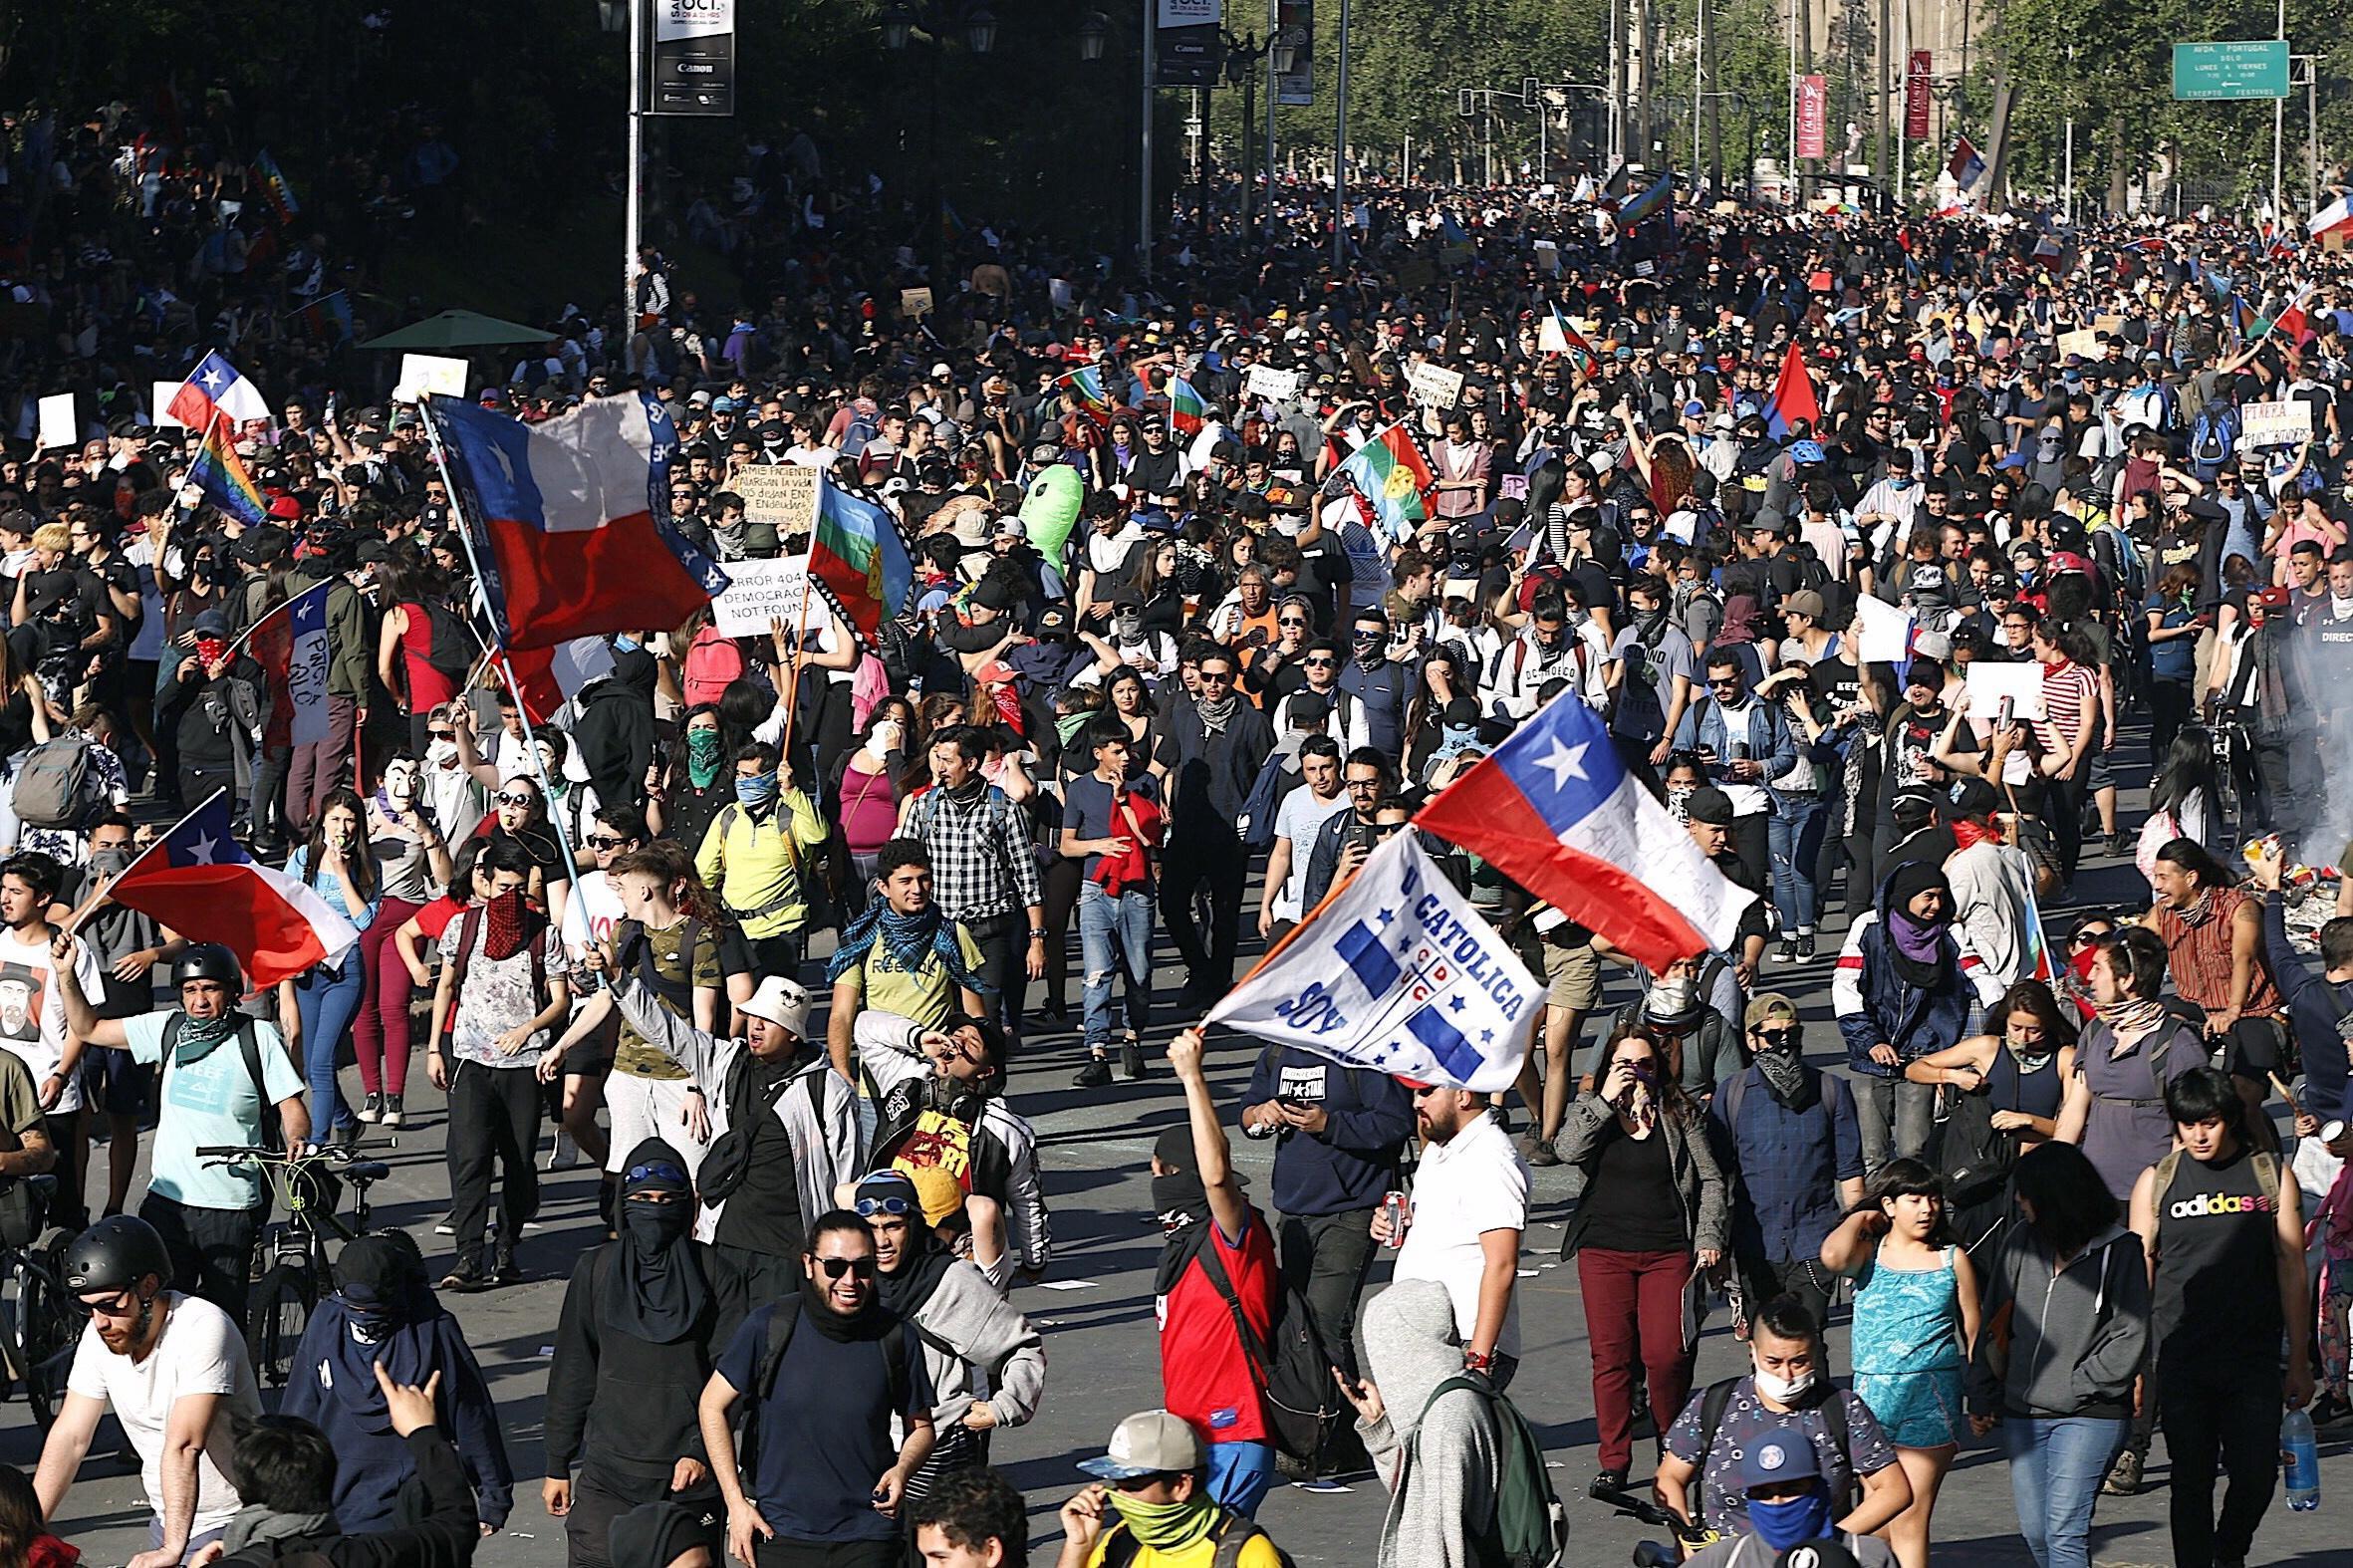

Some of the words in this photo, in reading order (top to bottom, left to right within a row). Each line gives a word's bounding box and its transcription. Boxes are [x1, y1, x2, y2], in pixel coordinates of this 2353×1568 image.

[1175, 44, 1204, 53] Canon
[677, 63, 713, 73] Canon
[777, 572, 801, 584] 404
[731, 607, 760, 619] NOT
[1837, 681, 1862, 691] KEE
[1415, 893, 1524, 1022] CATOLICA
[1274, 980, 1348, 1035] SOY
[1305, 1079, 1323, 1098] STAR
[2170, 1192, 2255, 1218] adidas
